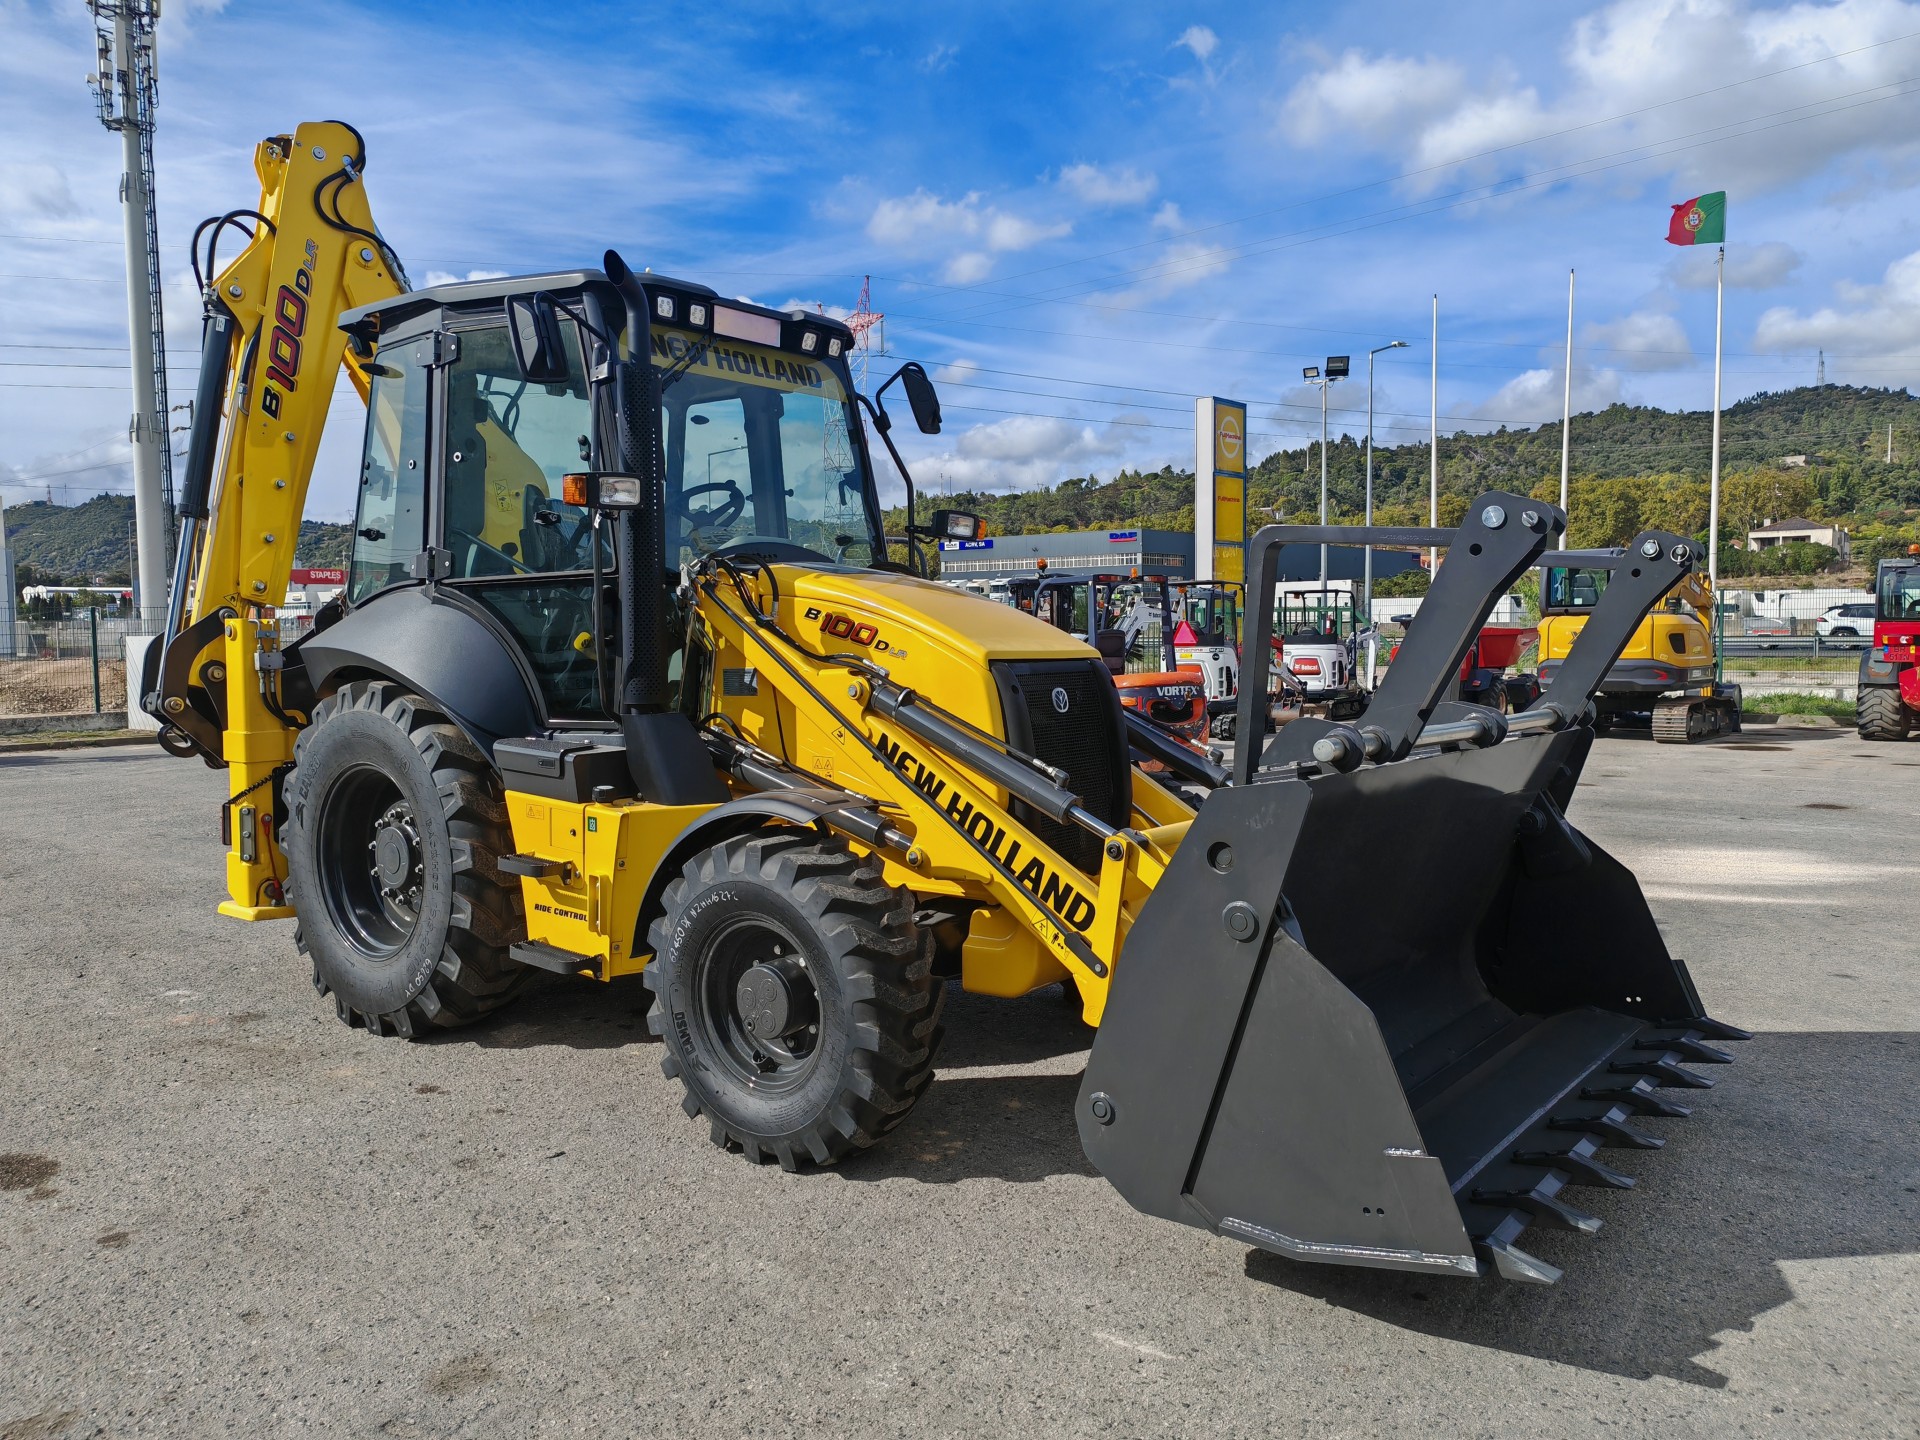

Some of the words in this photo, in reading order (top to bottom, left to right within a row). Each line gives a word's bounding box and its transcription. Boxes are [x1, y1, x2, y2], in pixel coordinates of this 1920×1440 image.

[651, 333, 708, 366] NEW
[713, 345, 823, 389] HOLLAND
[310, 571, 341, 579] STAPLES
[1156, 686, 1198, 696] VORTEX
[872, 732, 946, 803] NEW
[945, 791, 1097, 933] HOLLAND
[534, 903, 552, 913] RIDE
[553, 907, 588, 922] CONTROL
[674, 1011, 696, 1056] CAMSO
